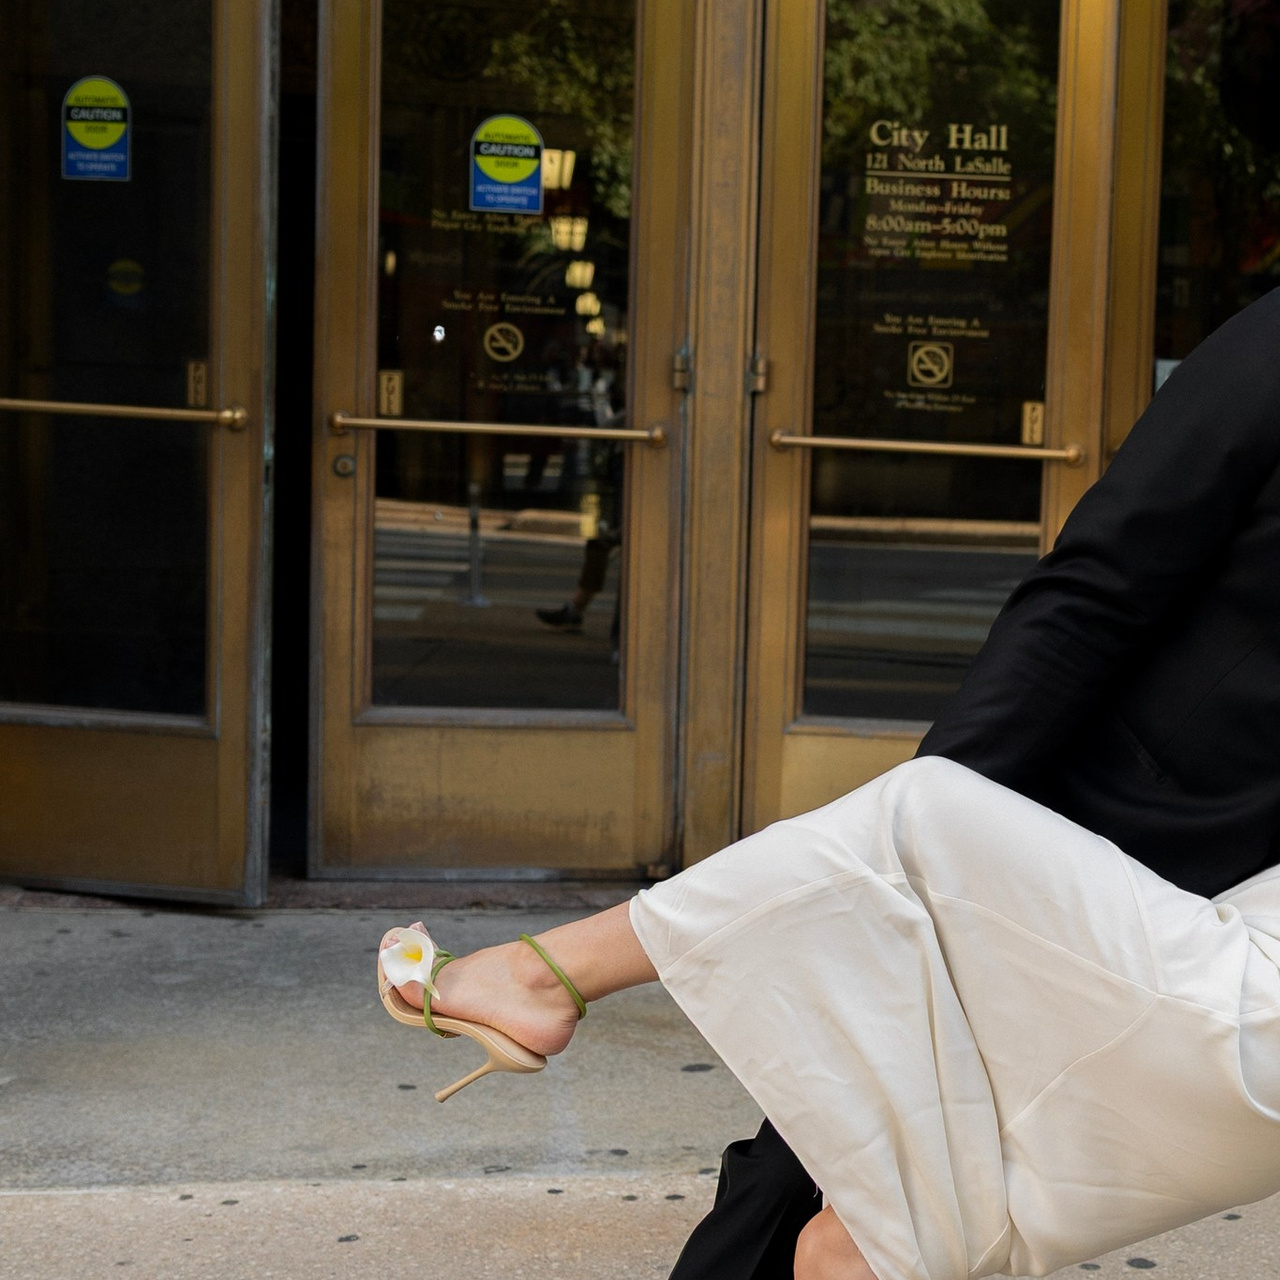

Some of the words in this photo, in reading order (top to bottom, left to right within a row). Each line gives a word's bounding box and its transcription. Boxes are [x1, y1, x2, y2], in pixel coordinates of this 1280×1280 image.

[70, 107, 123, 121] CAUTION
[869, 120, 929, 153] City
[947, 123, 1008, 151] Hall
[479, 142, 536, 157] CAUTION
[866, 152, 888, 169] 121
[898, 153, 945, 172] North
[954, 155, 1011, 175] LaSalle
[865, 177, 941, 197] Business
[952, 181, 1011, 200] Hours:
